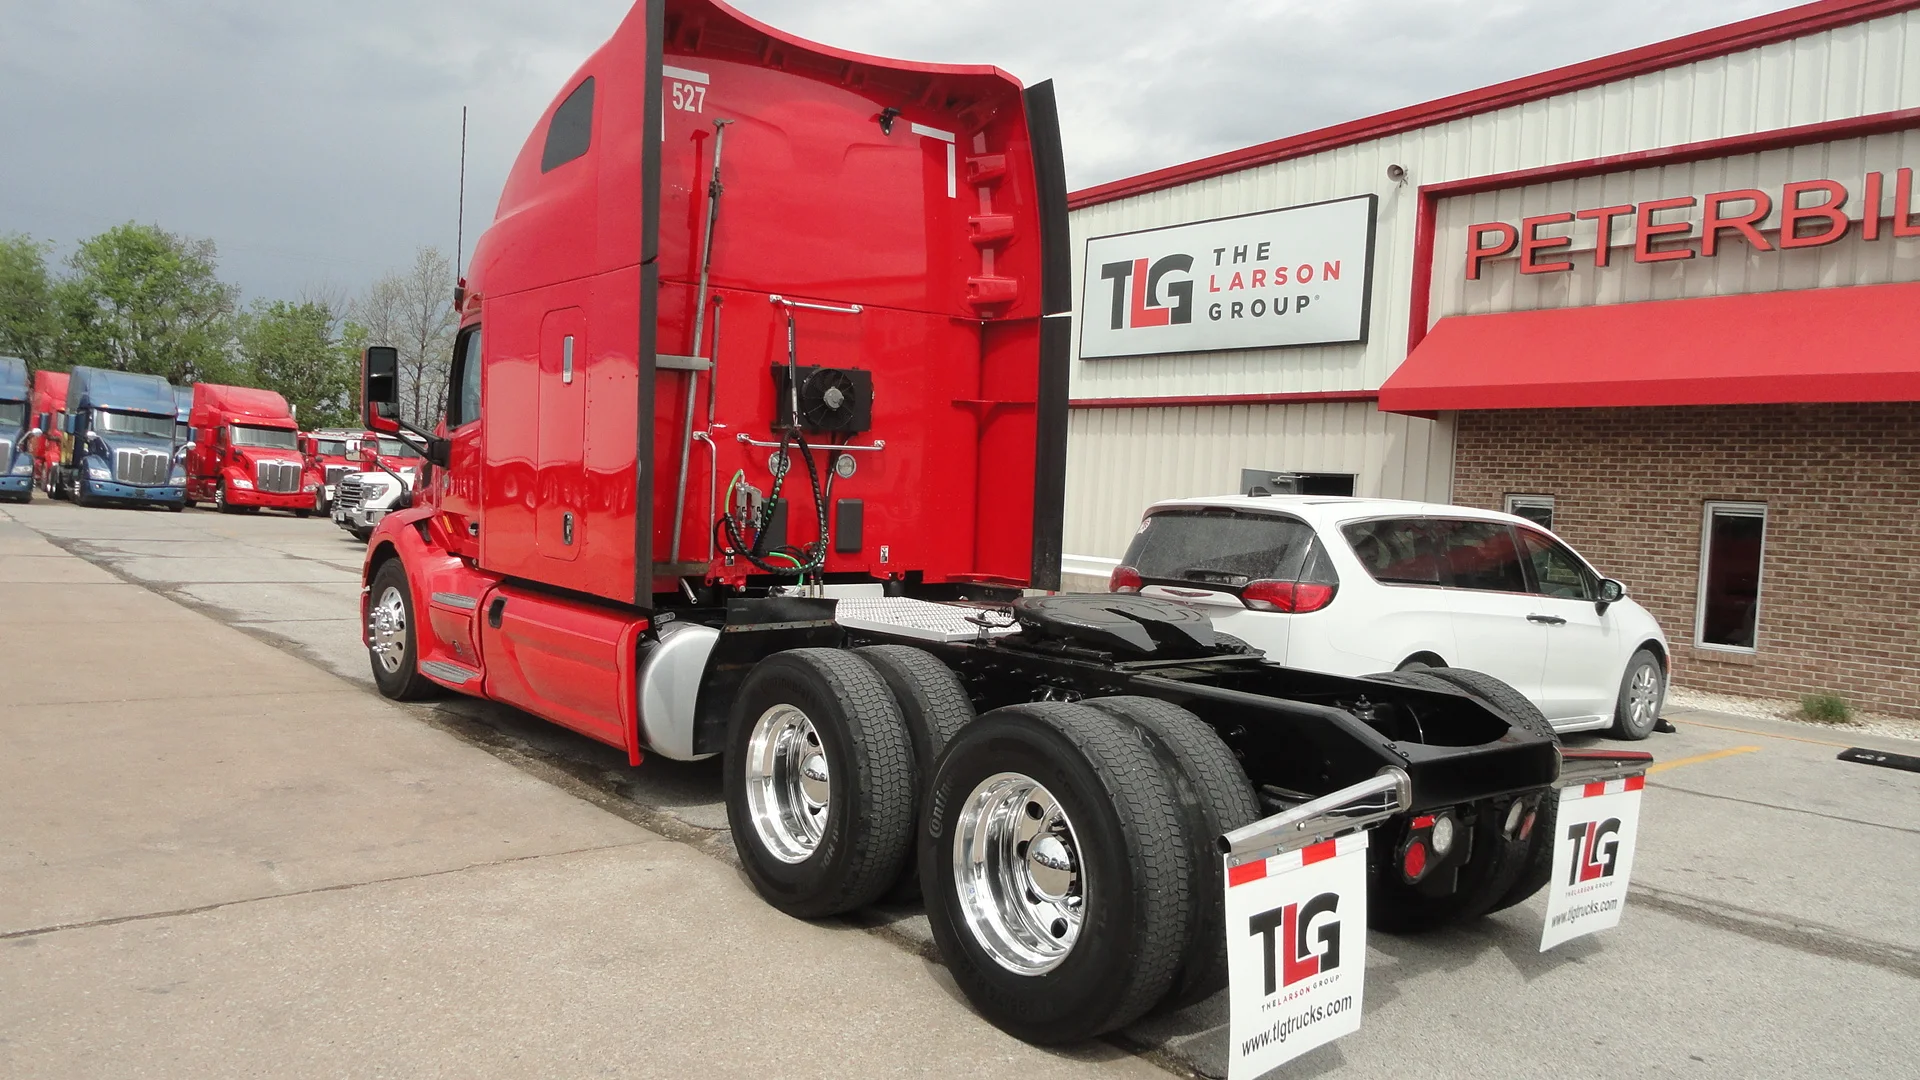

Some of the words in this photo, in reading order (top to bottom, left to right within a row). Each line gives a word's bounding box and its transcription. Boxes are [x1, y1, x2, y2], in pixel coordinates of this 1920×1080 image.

[672, 81, 706, 114] 527
[1209, 260, 1341, 293] LARSON
[1213, 241, 1271, 266] THE
[1100, 253, 1194, 330] TLG
[1567, 817, 1622, 887] TLG
[1551, 898, 1618, 929] www.tlgtrucks.com
[1249, 892, 1341, 997] TLG
[1242, 995, 1352, 1057] www.tlgtrucks.com
